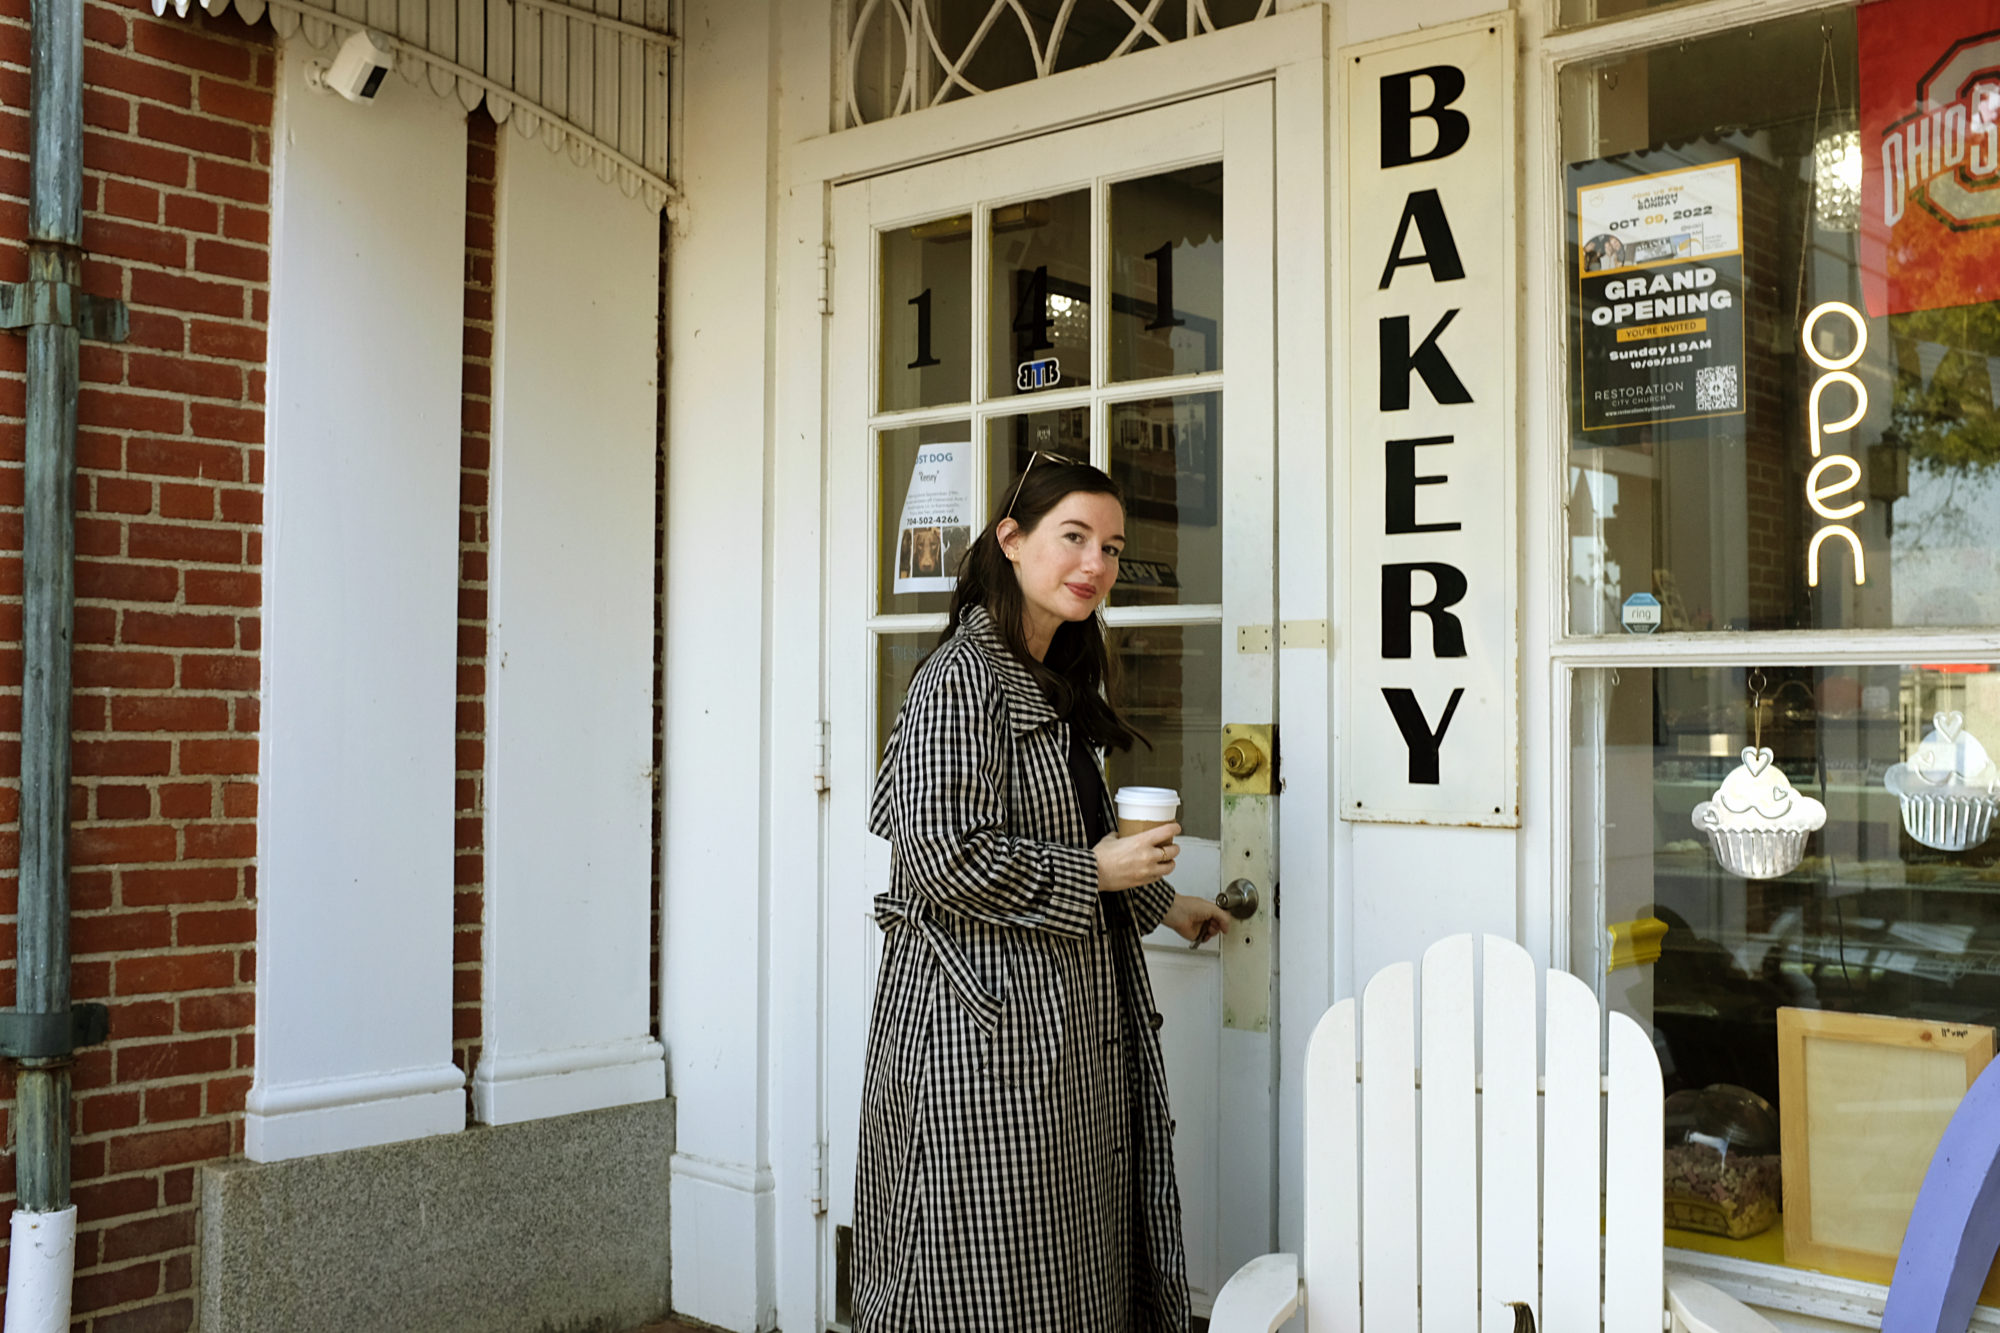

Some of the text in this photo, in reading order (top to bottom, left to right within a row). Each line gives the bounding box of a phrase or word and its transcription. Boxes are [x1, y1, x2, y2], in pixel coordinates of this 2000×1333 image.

[1882, 103, 1967, 228] OHIO
[1637, 192, 1678, 204] LAUNCH
[1637, 199, 1678, 211] SUNDAY
[1609, 218, 1640, 231] OCT
[1673, 205, 1713, 221] 2022
[1604, 267, 1717, 300] GRAND
[1591, 289, 1732, 326] OPENING
[1625, 321, 1697, 338] YOU'RE INVITED
[1609, 345, 1667, 361] Sunday
[1678, 338, 1712, 352] 9AM
[1630, 354, 1693, 370] 10/09/2022
[1594, 381, 1684, 401] RESTORATION
[1611, 394, 1667, 407] CITY CHURCH
[1378, 65, 1474, 784] BAKERY
[929, 452, 953, 463] DOG
[906, 516, 959, 526] 704-502-4266
[1631, 607, 1651, 621] ring
